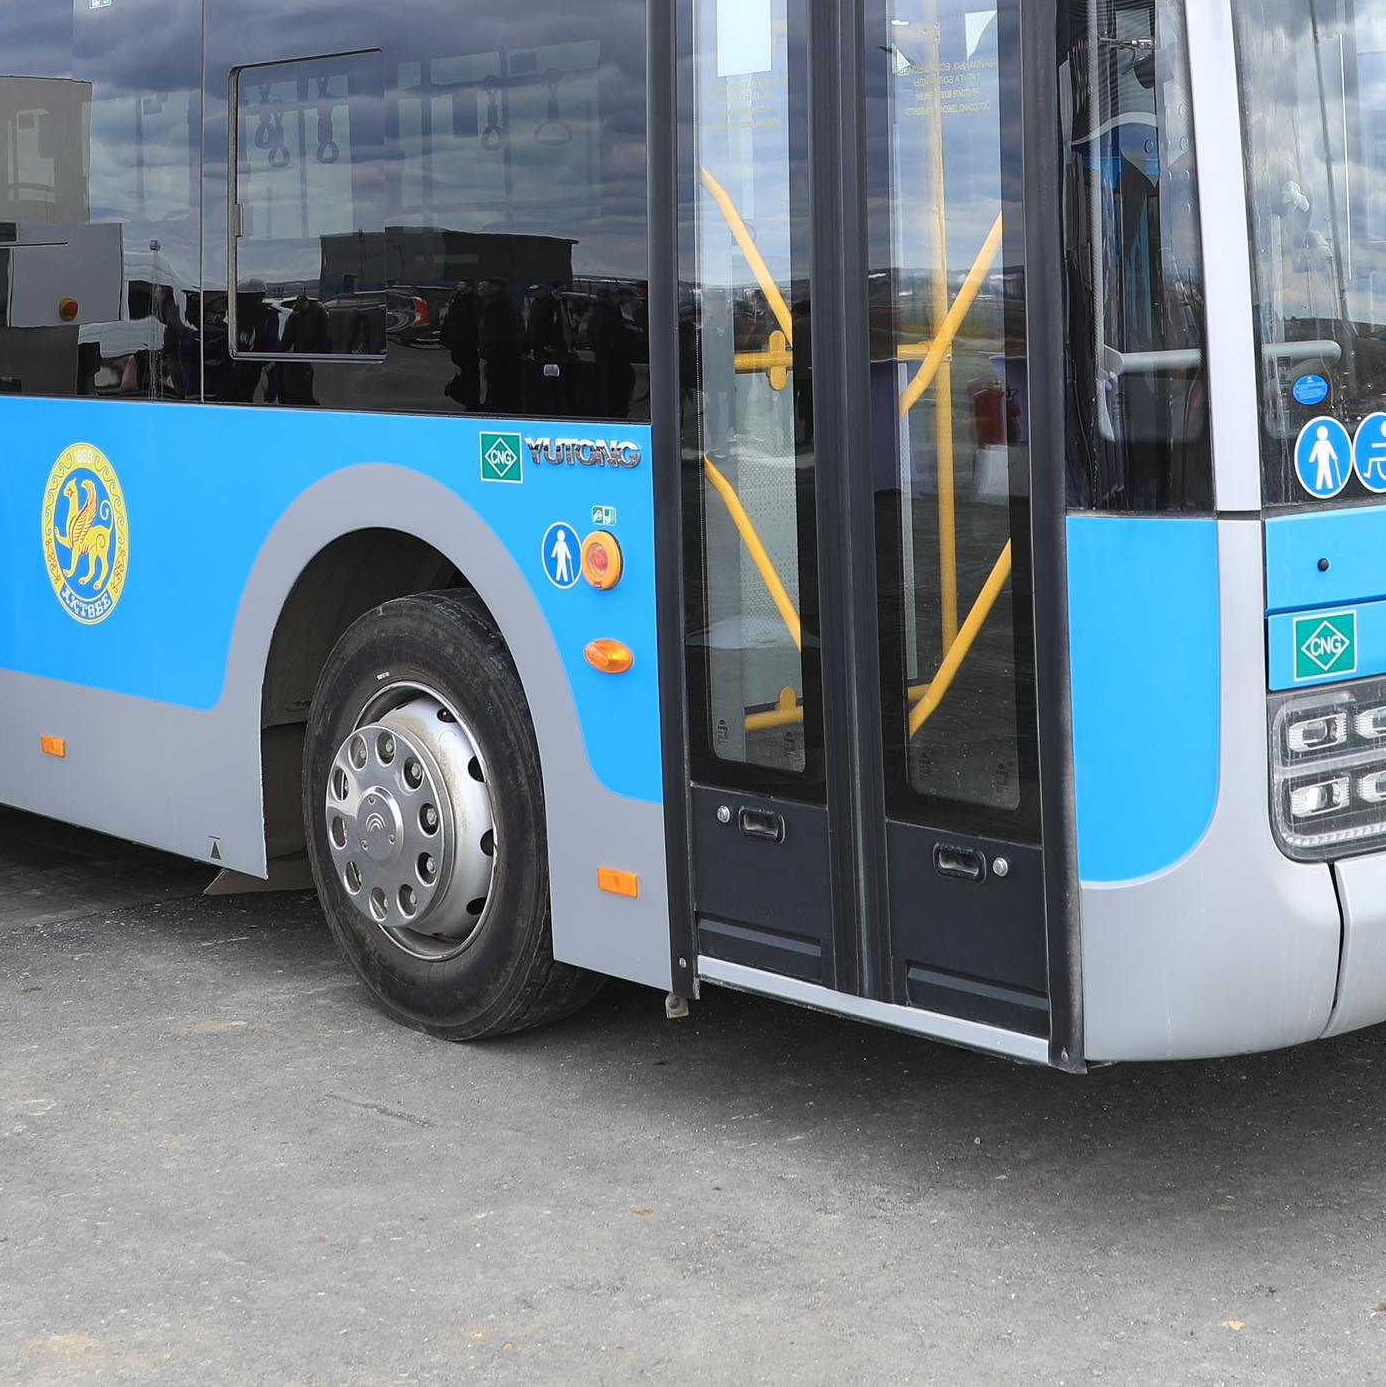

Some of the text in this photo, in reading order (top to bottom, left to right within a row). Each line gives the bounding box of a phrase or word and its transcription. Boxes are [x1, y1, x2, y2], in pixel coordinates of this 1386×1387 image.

[489, 449, 512, 465] CNG
[524, 437, 642, 470] YUTONG
[1310, 634, 1342, 657] CNG
